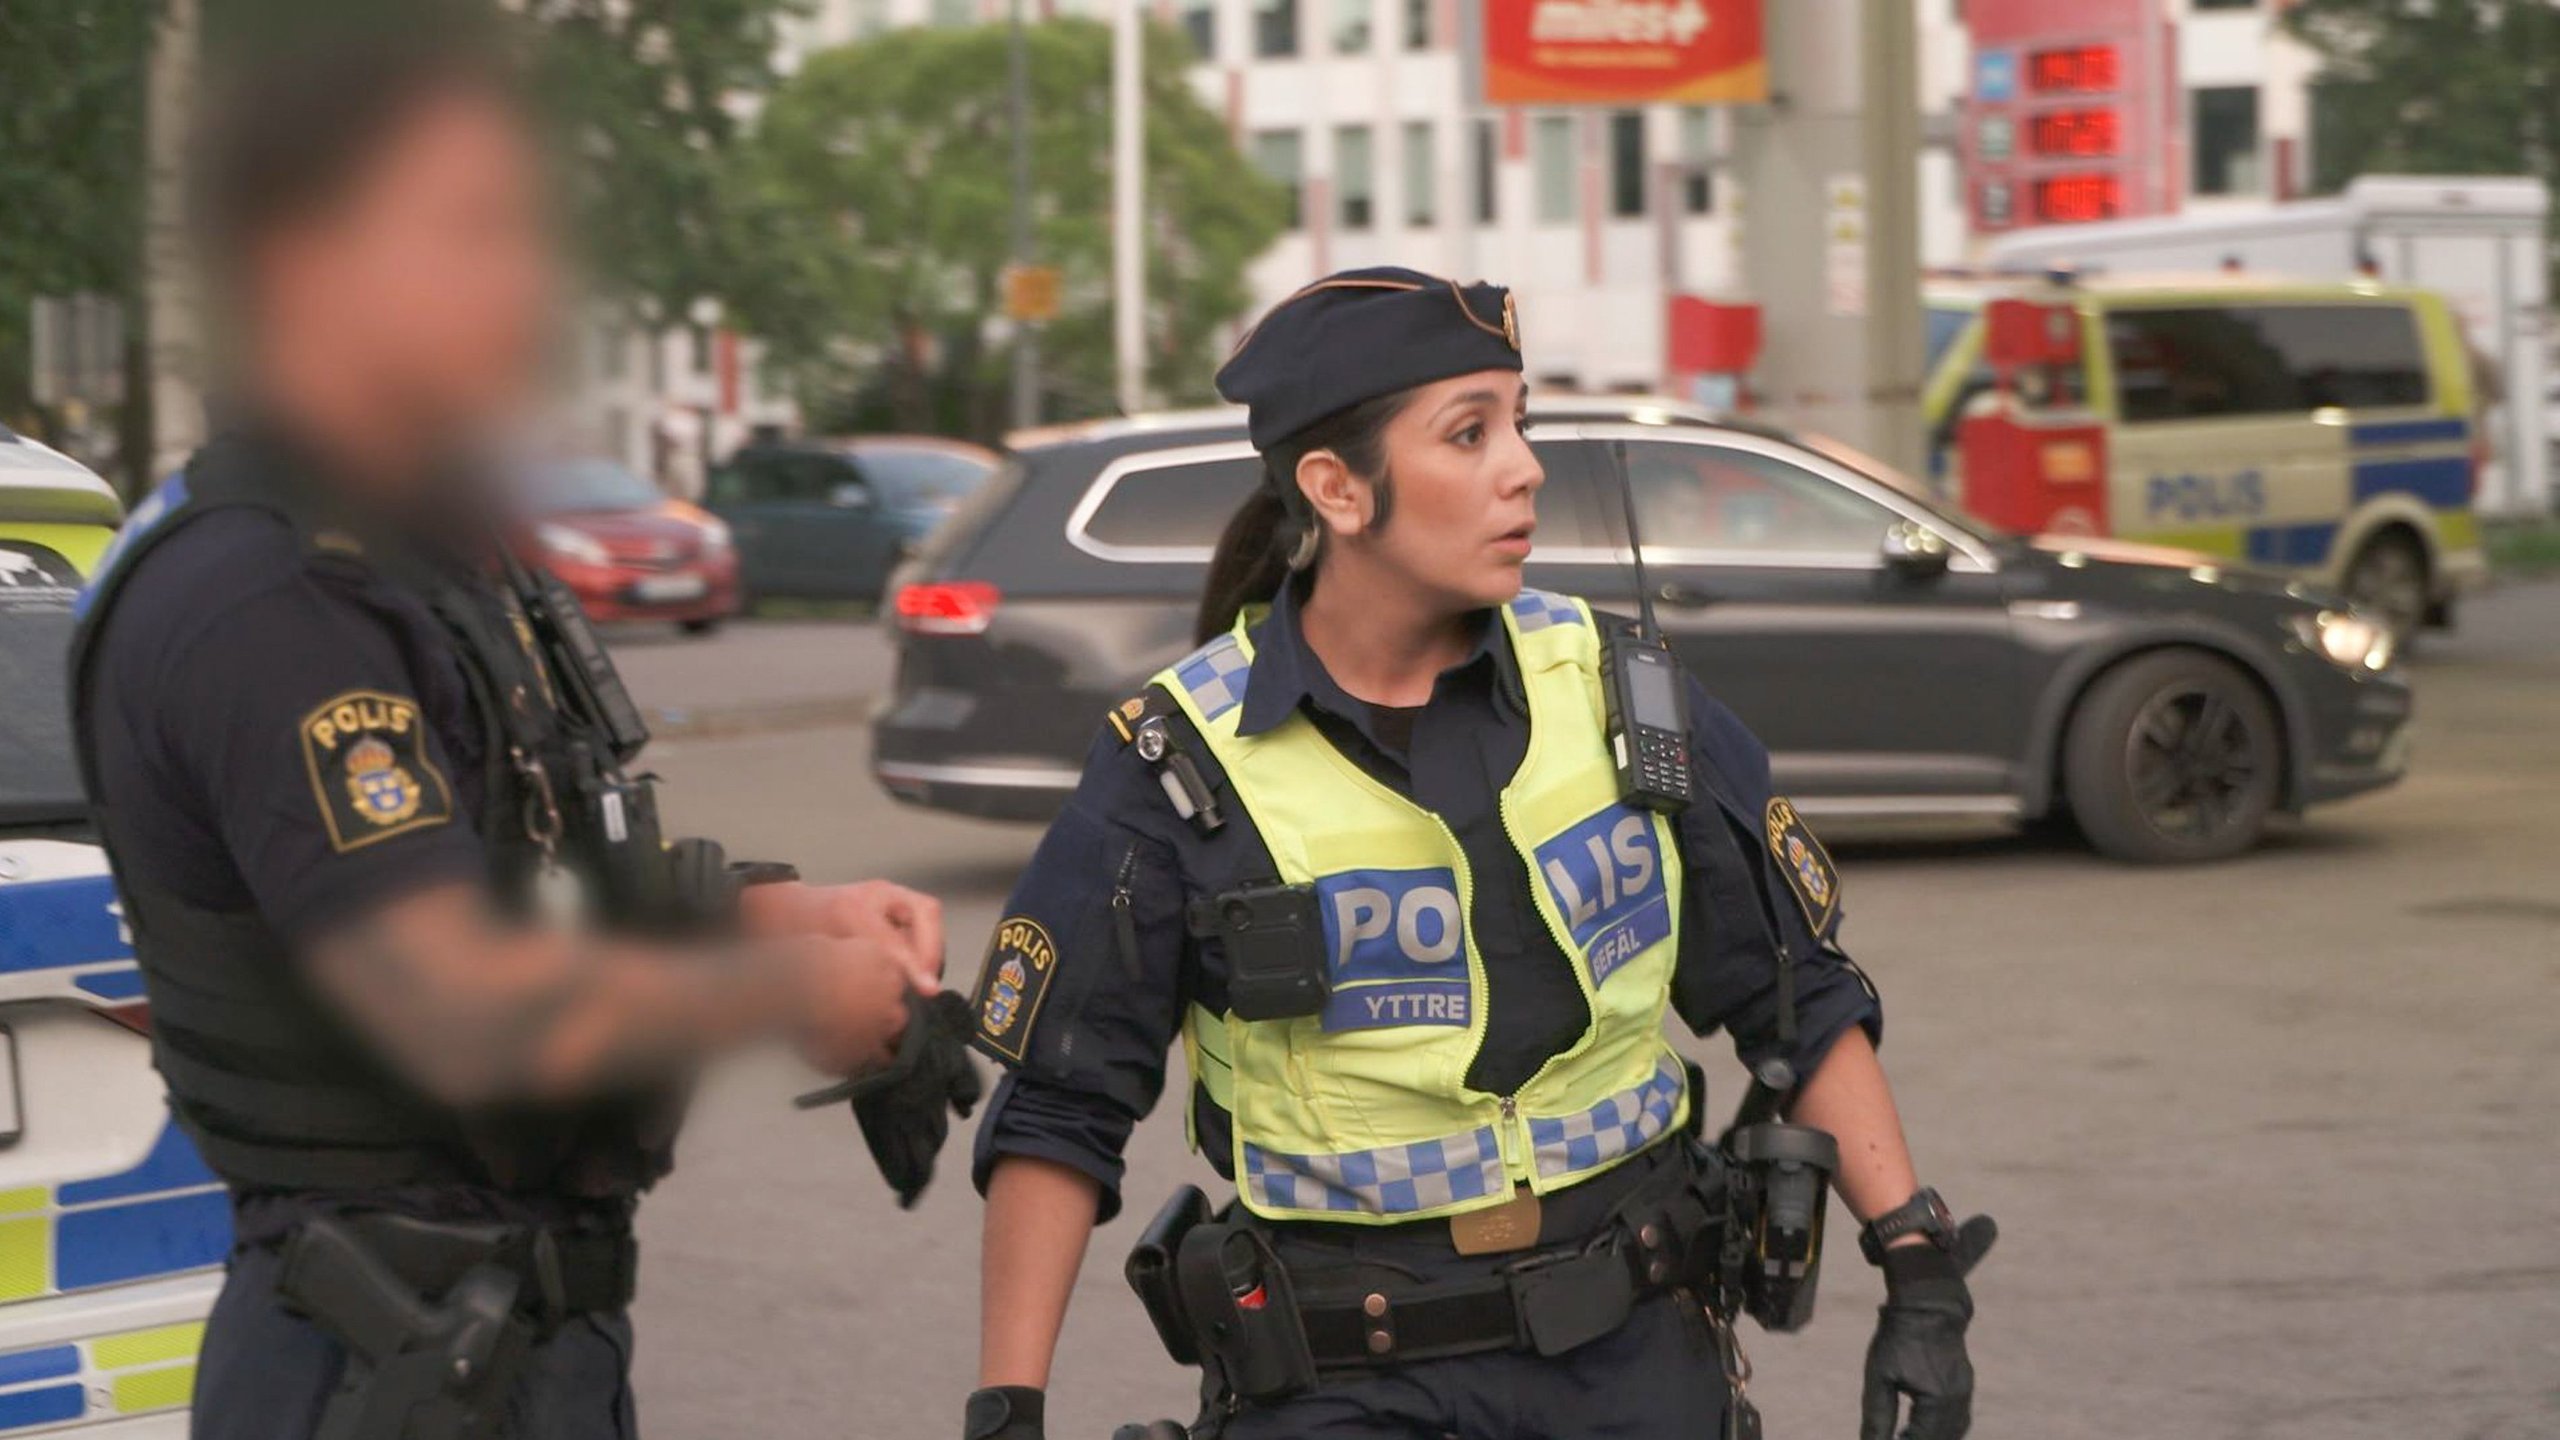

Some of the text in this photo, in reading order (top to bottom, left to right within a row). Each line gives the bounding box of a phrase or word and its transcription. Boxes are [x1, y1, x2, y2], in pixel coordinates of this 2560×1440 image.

[2145, 469, 2266, 520] POLIS
[312, 701, 413, 749] POLIS
[1334, 815, 1653, 965] PO LIS
[1000, 925, 1051, 971] POLIS
[1366, 993, 1466, 1020] YTTRE
